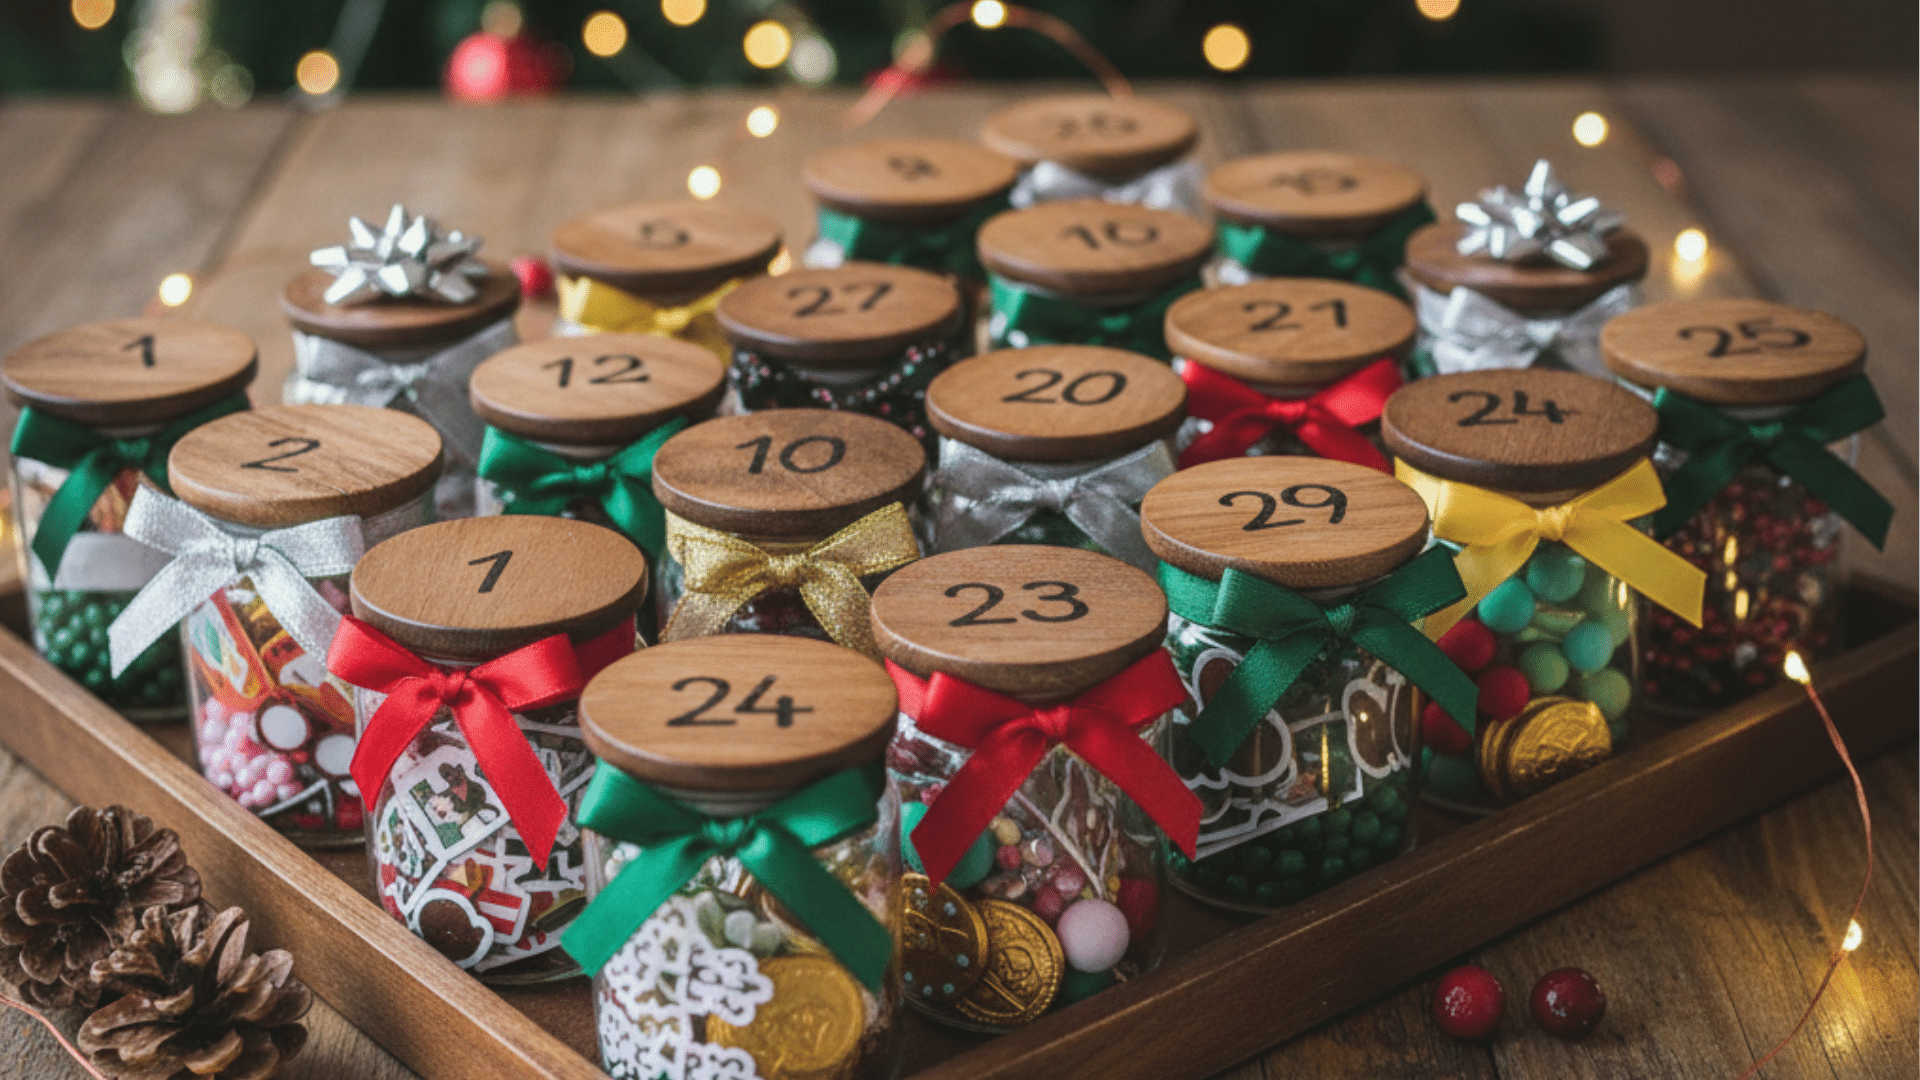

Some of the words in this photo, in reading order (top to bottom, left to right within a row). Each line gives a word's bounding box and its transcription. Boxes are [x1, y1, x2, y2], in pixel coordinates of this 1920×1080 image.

[786, 281, 894, 319] 27
[1241, 298, 1348, 334] 21
[124, 334, 157, 369] 1
[1677, 318, 1812, 360] 25
[542, 355, 652, 389] 12
[1001, 369, 1129, 407] 20
[1447, 390, 1582, 429] 24
[240, 436, 322, 473] 2
[733, 435, 848, 477] 10
[1217, 482, 1349, 533] 29
[467, 549, 514, 595] 1
[943, 580, 1090, 628] 23
[665, 675, 815, 730] 24
